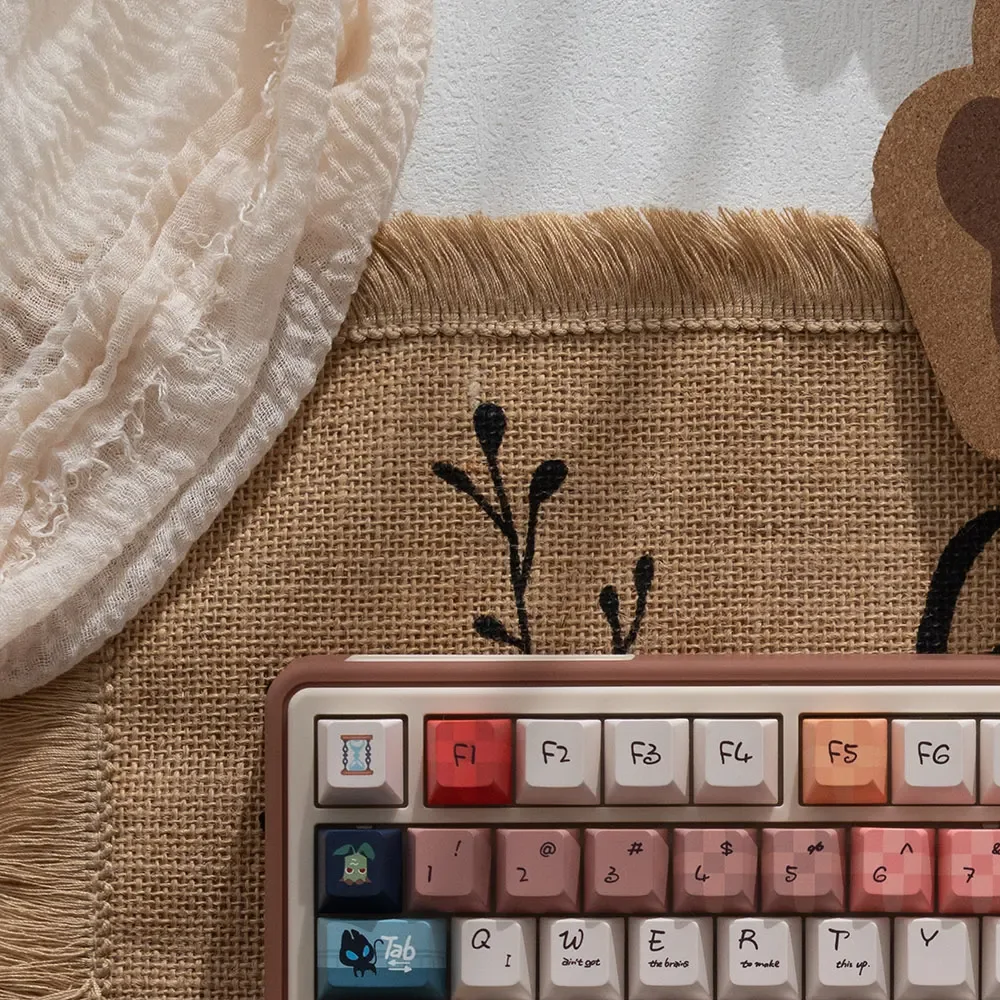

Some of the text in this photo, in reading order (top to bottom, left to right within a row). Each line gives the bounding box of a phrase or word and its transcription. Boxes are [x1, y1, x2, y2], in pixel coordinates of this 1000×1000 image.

[454, 743, 476, 767] F1
[542, 741, 570, 764] F2
[630, 741, 661, 765] F3
[720, 741, 752, 764] F4
[828, 740, 858, 764] F5
[918, 741, 950, 765] F6
[454, 840, 462, 856] !
[540, 842, 556, 857] @
[627, 842, 643, 855] #
[720, 841, 733, 856] $
[992, 843, 1000, 854] &
[426, 866, 433, 883] 1
[517, 867, 528, 883] 2
[604, 866, 620, 883] 3
[695, 865, 710, 882] 4
[785, 866, 798, 882] 5
[872, 866, 887, 883] 6
[963, 867, 975, 883] 7
[472, 928, 490, 950] Q
[559, 928, 584, 950] W
[648, 930, 665, 951] E
[739, 929, 758, 950] R
[828, 928, 850, 951] T
[921, 928, 939, 947] Y
[381, 935, 416, 960] Tab
[505, 955, 511, 967] I
[561, 957, 601, 968] ain't got
[648, 960, 662, 968] the
[740, 960, 753, 968] to
[836, 959, 871, 976] this up.
